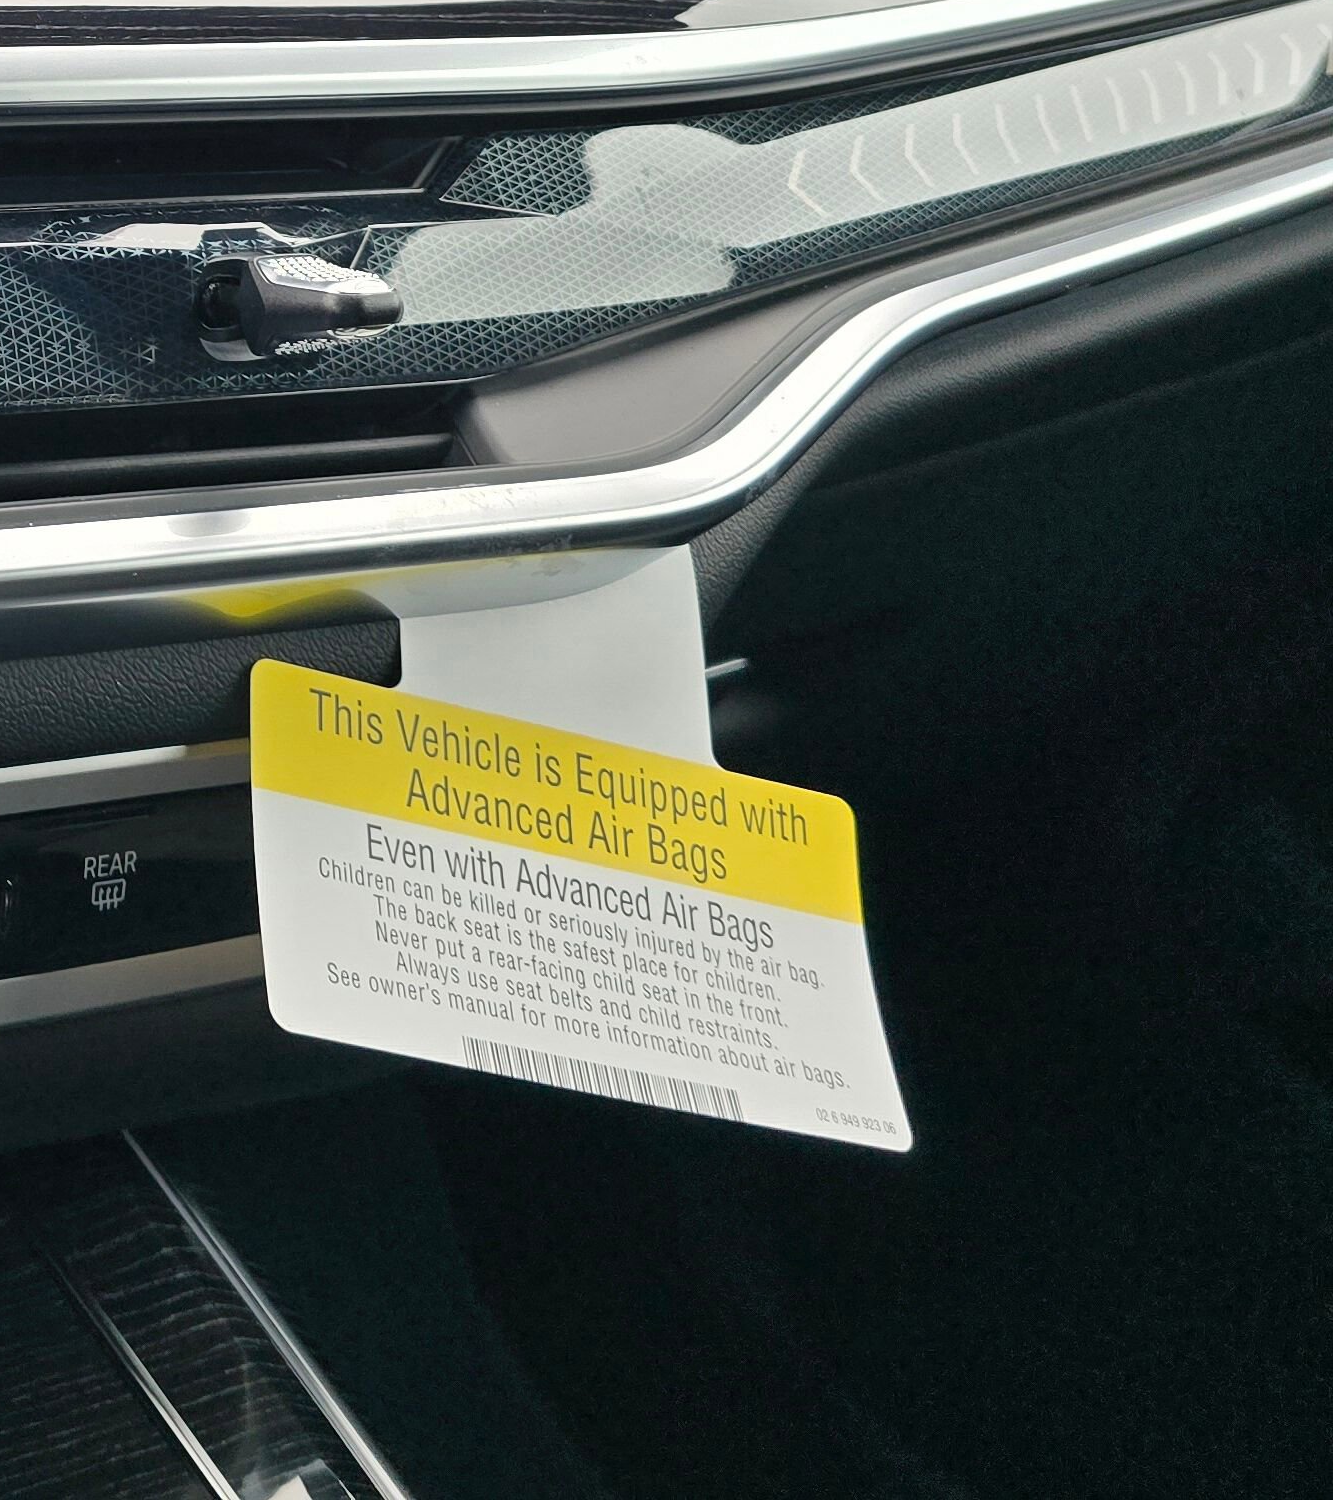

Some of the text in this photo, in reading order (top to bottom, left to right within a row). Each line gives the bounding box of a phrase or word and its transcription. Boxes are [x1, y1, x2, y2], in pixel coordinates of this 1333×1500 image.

[309, 688, 808, 845] This Vehicle is Equipped with
[83, 850, 137, 880] REAR
[406, 768, 727, 884] Advanced Air Bags
[318, 856, 825, 990] Children can be killed or seriously injured by the air bag.
[366, 823, 774, 952] Even with Advanced Air Bags
[373, 893, 782, 1002] The back seat is the safest place for children.
[375, 919, 789, 1028] Never put a rear-facing child seat in the front.
[396, 950, 778, 1051] Always use seat belts and child restraints.
[327, 962, 850, 1090] See owner's manual for more information about air bags.
